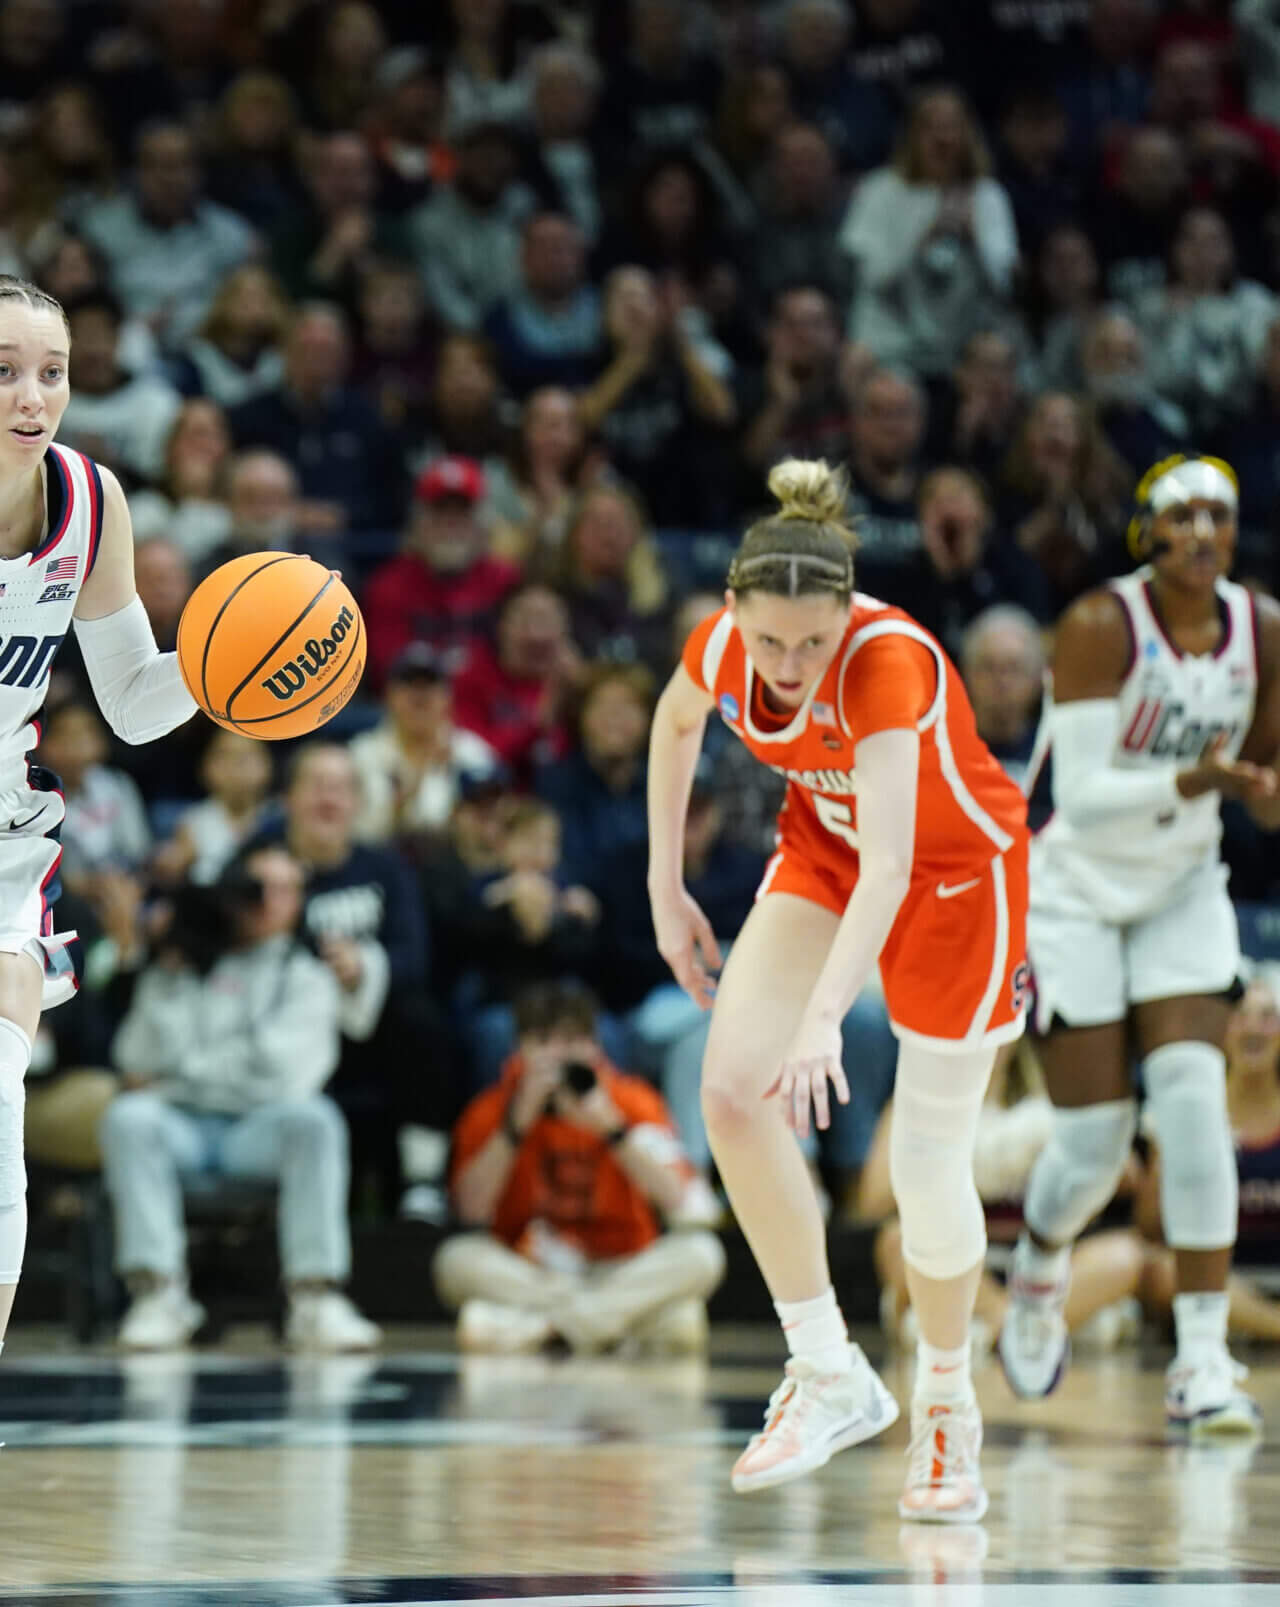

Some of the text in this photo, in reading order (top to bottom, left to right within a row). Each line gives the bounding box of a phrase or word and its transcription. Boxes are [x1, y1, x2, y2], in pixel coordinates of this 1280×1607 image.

[45, 583, 70, 592] BIG
[39, 591, 76, 600] EAST
[261, 604, 355, 701] Wilson
